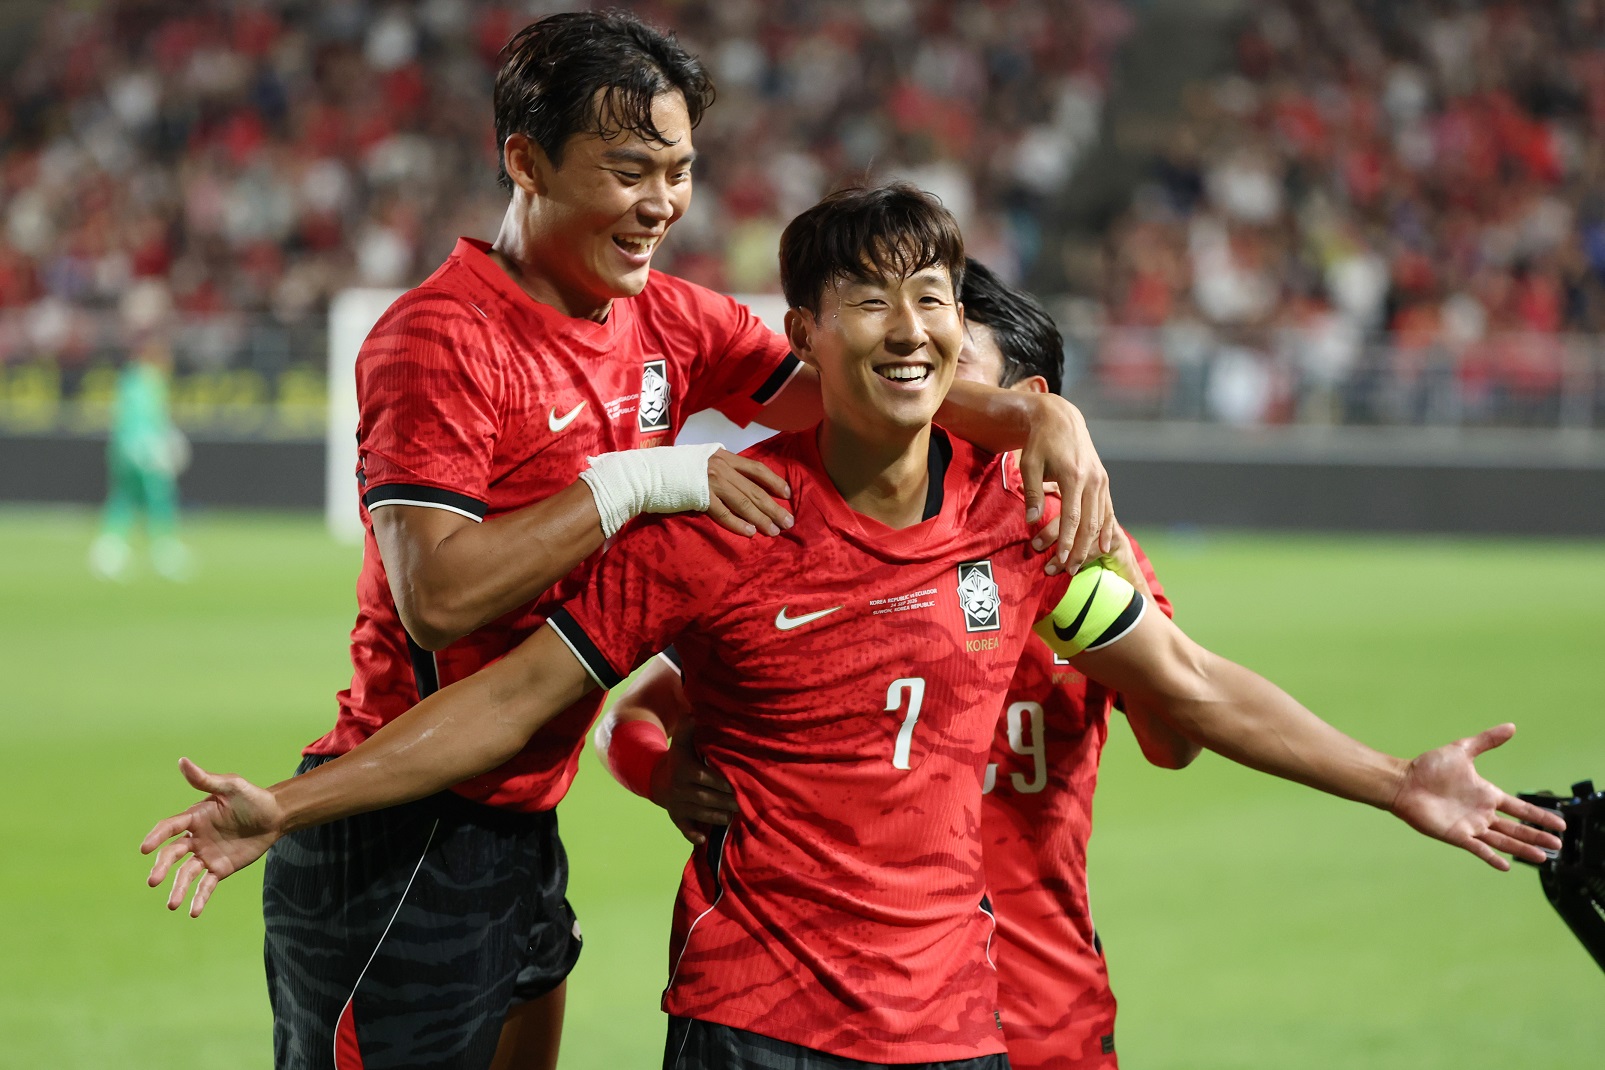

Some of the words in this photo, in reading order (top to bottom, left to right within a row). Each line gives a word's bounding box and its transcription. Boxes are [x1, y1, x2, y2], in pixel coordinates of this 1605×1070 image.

[888, 594, 910, 603] REPUBLIC
[915, 588, 938, 597] ECUADOR
[911, 601, 935, 610] REPUBLIC
[966, 636, 999, 652] KOREA
[883, 677, 926, 770] 7
[982, 701, 1048, 794] 9
